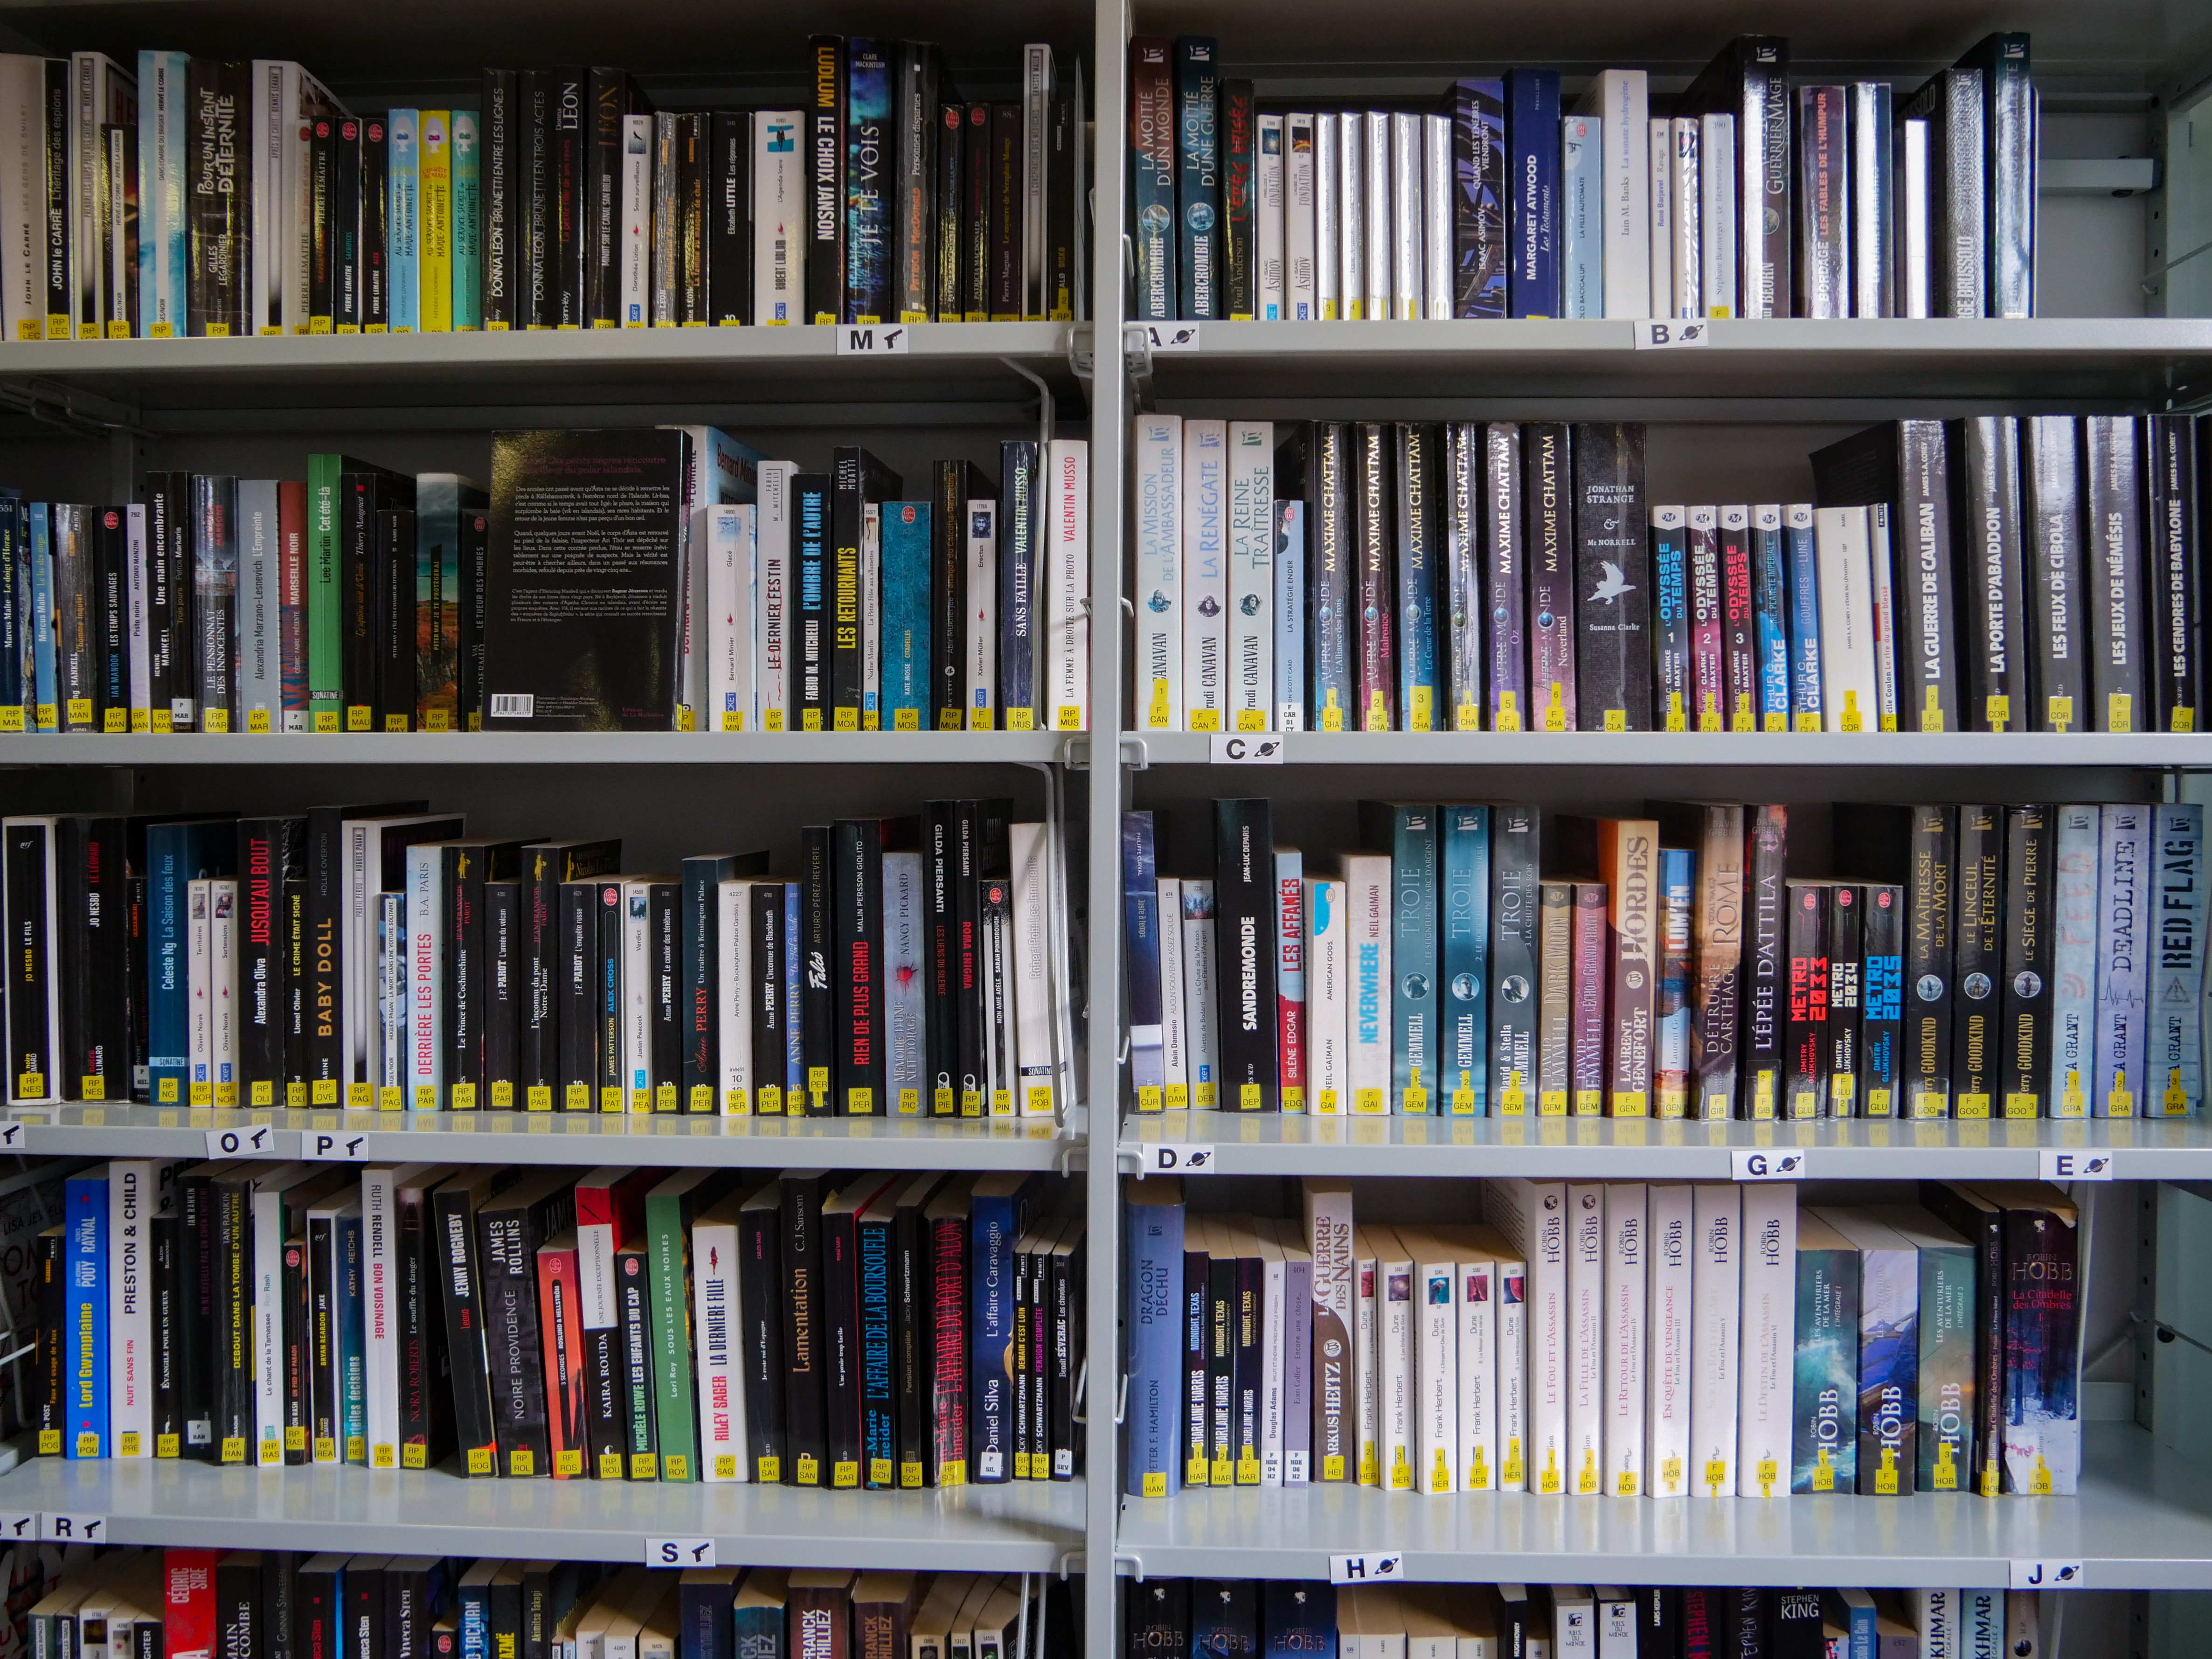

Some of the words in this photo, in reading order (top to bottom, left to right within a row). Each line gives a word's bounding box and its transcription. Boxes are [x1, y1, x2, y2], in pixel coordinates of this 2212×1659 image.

[817, 48, 833, 107] LUDLUM
[817, 117, 833, 133] LE
[1138, 93, 1153, 150] MOITIÉ
[1156, 79, 1168, 143] MONDE
[1817, 93, 1827, 150] L'HUMPUR
[817, 137, 834, 183] CHOIX
[861, 127, 879, 180] VOIS
[1141, 153, 1154, 169] LA
[1157, 146, 1171, 186] D'UN
[1621, 156, 1628, 167] La
[1818, 153, 1828, 169] DE
[1269, 166, 1279, 207] FONDATION
[1526, 154, 1536, 209] ATWOOD
[1818, 172, 1828, 212] FABLES
[817, 185, 833, 241] JANSON
[861, 190, 879, 215] TE
[1540, 185, 1550, 232] Testaments
[1622, 203, 1629, 214] M.
[860, 219, 879, 245] JE
[1819, 214, 1828, 235] LES
[218, 234, 227, 286] LEGARDINIER
[1526, 212, 1536, 280] MARGARET
[1817, 241, 1828, 302] BORDAGE
[850, 331, 873, 349] M
[1651, 325, 1669, 344] B
[1064, 457, 1075, 490] MUSSO
[1200, 462, 1218, 553] RENÉGATE
[1587, 494, 1634, 503] STRANGE
[155, 493, 164, 556] encombrante
[253, 512, 262, 556] L'Empreinte
[1064, 494, 1075, 542] VALENTIN
[1604, 519, 1619, 530] &
[1921, 503, 1935, 569] CALIBAN
[155, 559, 165, 583] main
[1202, 557, 1217, 578] LA
[1922, 572, 1937, 592] DE
[155, 587, 165, 605] Une
[254, 561, 263, 637] Marzano-Lesnevich
[838, 548, 856, 625] RETOURNANTS
[838, 628, 856, 648] LES
[1922, 596, 1938, 656] GUERRE
[255, 639, 264, 680] Alexandria
[1925, 659, 1939, 678] LA
[312, 691, 338, 700] SONATINE
[1227, 739, 1245, 760] C
[251, 839, 268, 875] BOUT
[935, 824, 943, 856] GILDA
[163, 854, 173, 875] feux
[2164, 840, 2194, 911] FLAG
[163, 877, 173, 893] des
[935, 859, 944, 913] PIERSANTI
[1369, 885, 1378, 918] GAIMAN
[1622, 836, 1649, 962] HORDES
[161, 895, 174, 924] Saison
[251, 878, 270, 945] JUSQU'AU
[1278, 879, 1300, 941] AFFAMÉS
[1401, 868, 1420, 938] TROIE
[2112, 841, 2135, 972] DEADLINE
[162, 926, 174, 939] La
[1370, 921, 1379, 937] NEIL
[1755, 874, 1776, 977] D'ATTILA
[162, 943, 176, 955] Ng
[317, 918, 331, 972] DOLL
[417, 934, 431, 980] PORTES
[1283, 945, 1301, 972] LES
[2163, 918, 2192, 969] RED
[162, 958, 174, 990] Celeste
[254, 958, 266, 976] Oliva
[853, 942, 869, 982] GRAND
[1243, 916, 1256, 1030] SANDREMONDE
[254, 979, 266, 1025] Alexandra
[418, 985, 431, 1009] LES
[853, 986, 869, 1013] PLUS
[1359, 943, 1379, 1044] NEVERWHERE
[1791, 958, 1807, 1021] METRO
[1809, 958, 1827, 1020] 2033
[317, 979, 332, 1037] BABY
[853, 1016, 869, 1032] DE
[1755, 986, 1773, 1049] L'ÉPÉE
[415, 1013, 433, 1075] DERRIÈRE
[1287, 1011, 1296, 1043] EDGAR
[854, 1035, 869, 1065] RIEN
[1288, 1046, 1297, 1079] SILÈNE
[221, 1133, 238, 1152] O
[317, 1136, 333, 1155] P
[1158, 1149, 1177, 1168] D
[1747, 1155, 1767, 1174] G
[2057, 1156, 2073, 1176] E
[124, 1173, 136, 1221] CHILD
[125, 1224, 136, 1237] &
[449, 1214, 463, 1259] ROGNEBY
[491, 1222, 504, 1263] JAMES
[507, 1220, 523, 1275] ROLLINS
[1547, 1217, 1560, 1264] HOBB
[124, 1243, 137, 1314] PRESTON
[452, 1262, 469, 1297] JENNY
[706, 1279, 724, 1301] FILLE
[1140, 1260, 1153, 1325] DRAGON
[1156, 1268, 1169, 1317] DÉCHU
[707, 1304, 726, 1348] DERNIÈRE
[790, 1268, 810, 1373] Lamentation
[78, 1303, 93, 1374] Gwynplaine
[709, 1352, 726, 1366] LA
[78, 1378, 92, 1409] Lord
[714, 1376, 727, 1409] SAGER
[1434, 1378, 1442, 1409] Herbert
[715, 1412, 728, 1442] RILEY
[56, 1519, 71, 1536] R
[662, 1543, 679, 1562] S
[1346, 1559, 1365, 1578] H
[167, 1568, 189, 1603] CÉDRIC
[190, 1568, 207, 1590] SIRE
[2029, 1564, 2042, 1583] J
[1781, 1595, 1819, 1605] STEPHEN
[1781, 1606, 1819, 1619] KING
